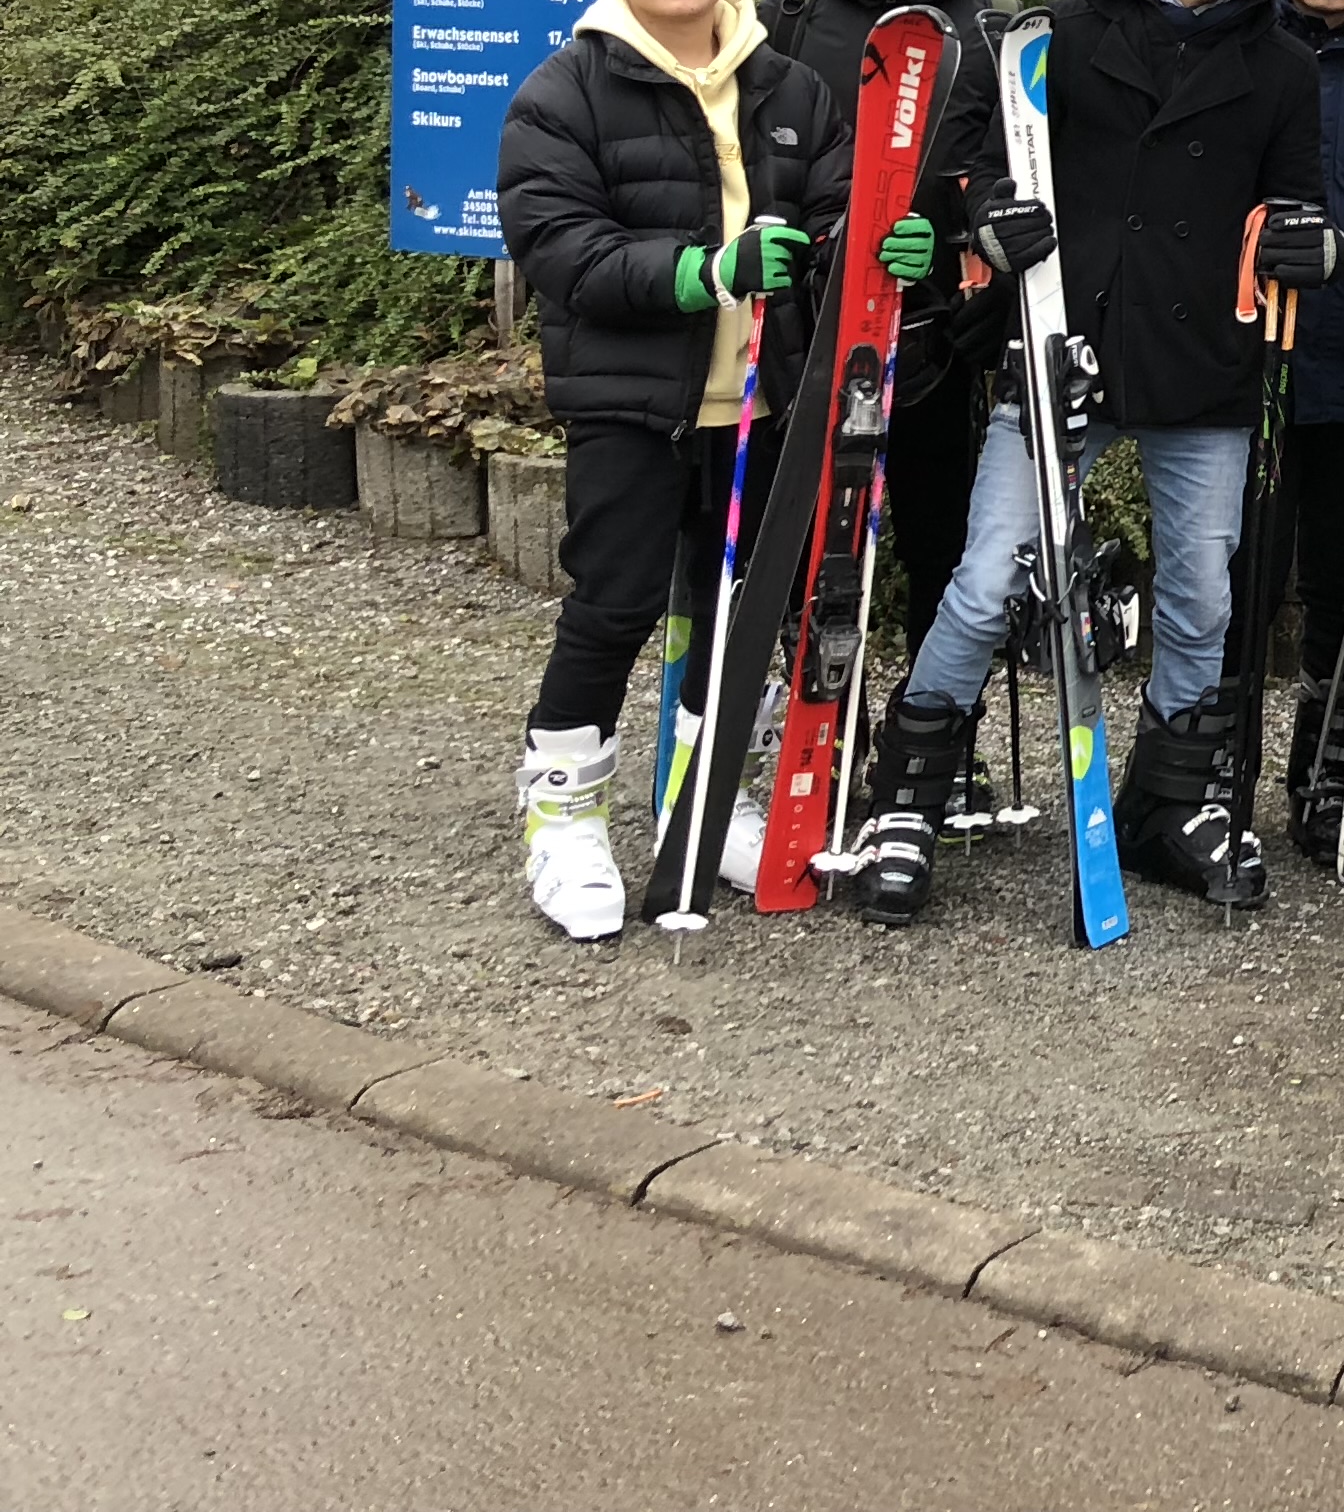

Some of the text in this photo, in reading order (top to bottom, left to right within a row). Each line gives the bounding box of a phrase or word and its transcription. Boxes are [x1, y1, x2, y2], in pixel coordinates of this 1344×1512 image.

[412, 25, 520, 44] Erwachsenenset
[412, 68, 509, 87] Snowboardset
[890, 45, 927, 149] Völkl
[412, 111, 462, 127] Skikurs
[1024, 123, 1040, 201] YNASTAR
[434, 226, 503, 239] www.skischule
